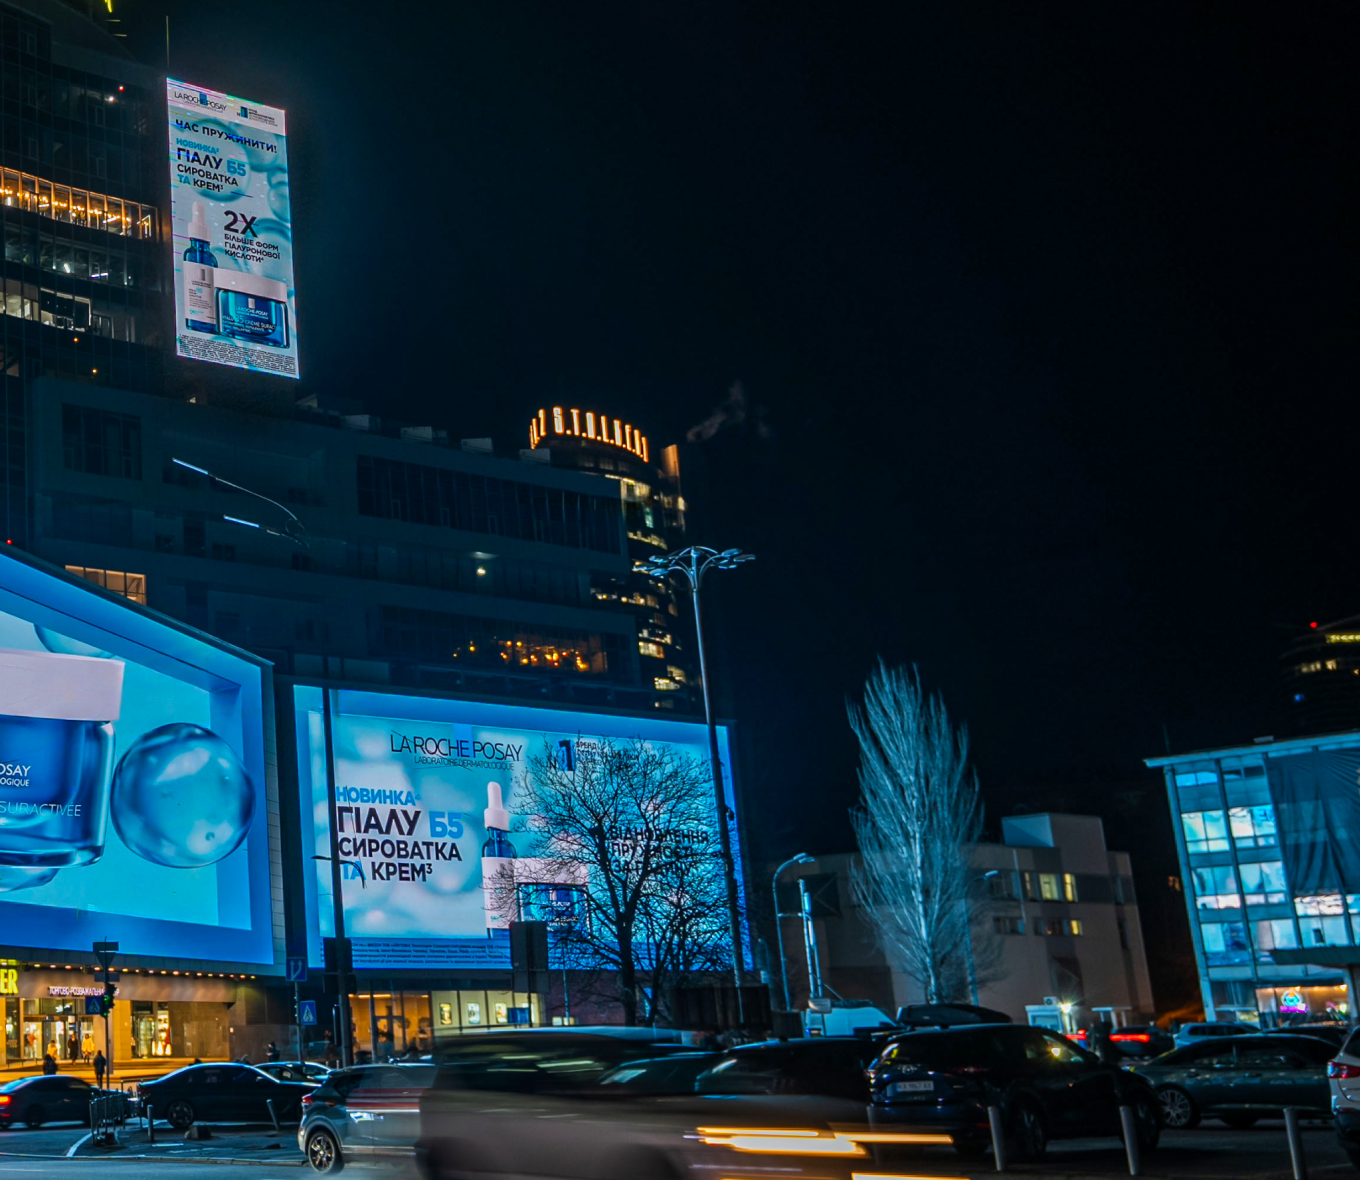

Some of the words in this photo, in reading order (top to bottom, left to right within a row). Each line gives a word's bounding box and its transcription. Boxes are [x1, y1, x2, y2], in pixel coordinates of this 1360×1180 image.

[175, 119, 199, 132] ЧАС
[202, 126, 277, 154] ПРУЖИНИТИ!
[177, 147, 223, 170] ГІАЛУ
[226, 158, 247, 177] Б5
[177, 164, 239, 187] СИРОВАТКА
[177, 173, 191, 185] ТА
[224, 233, 254, 246] БІЛЬШЕ
[255, 241, 279, 251] ФОРМ
[390, 734, 409, 753] LA
[413, 736, 469, 758] ROCHE
[473, 741, 523, 762] POSAY
[337, 805, 422, 836] ГІАЛУ
[428, 811, 464, 839] Б5
[338, 837, 463, 862] СИРОВАТКА
